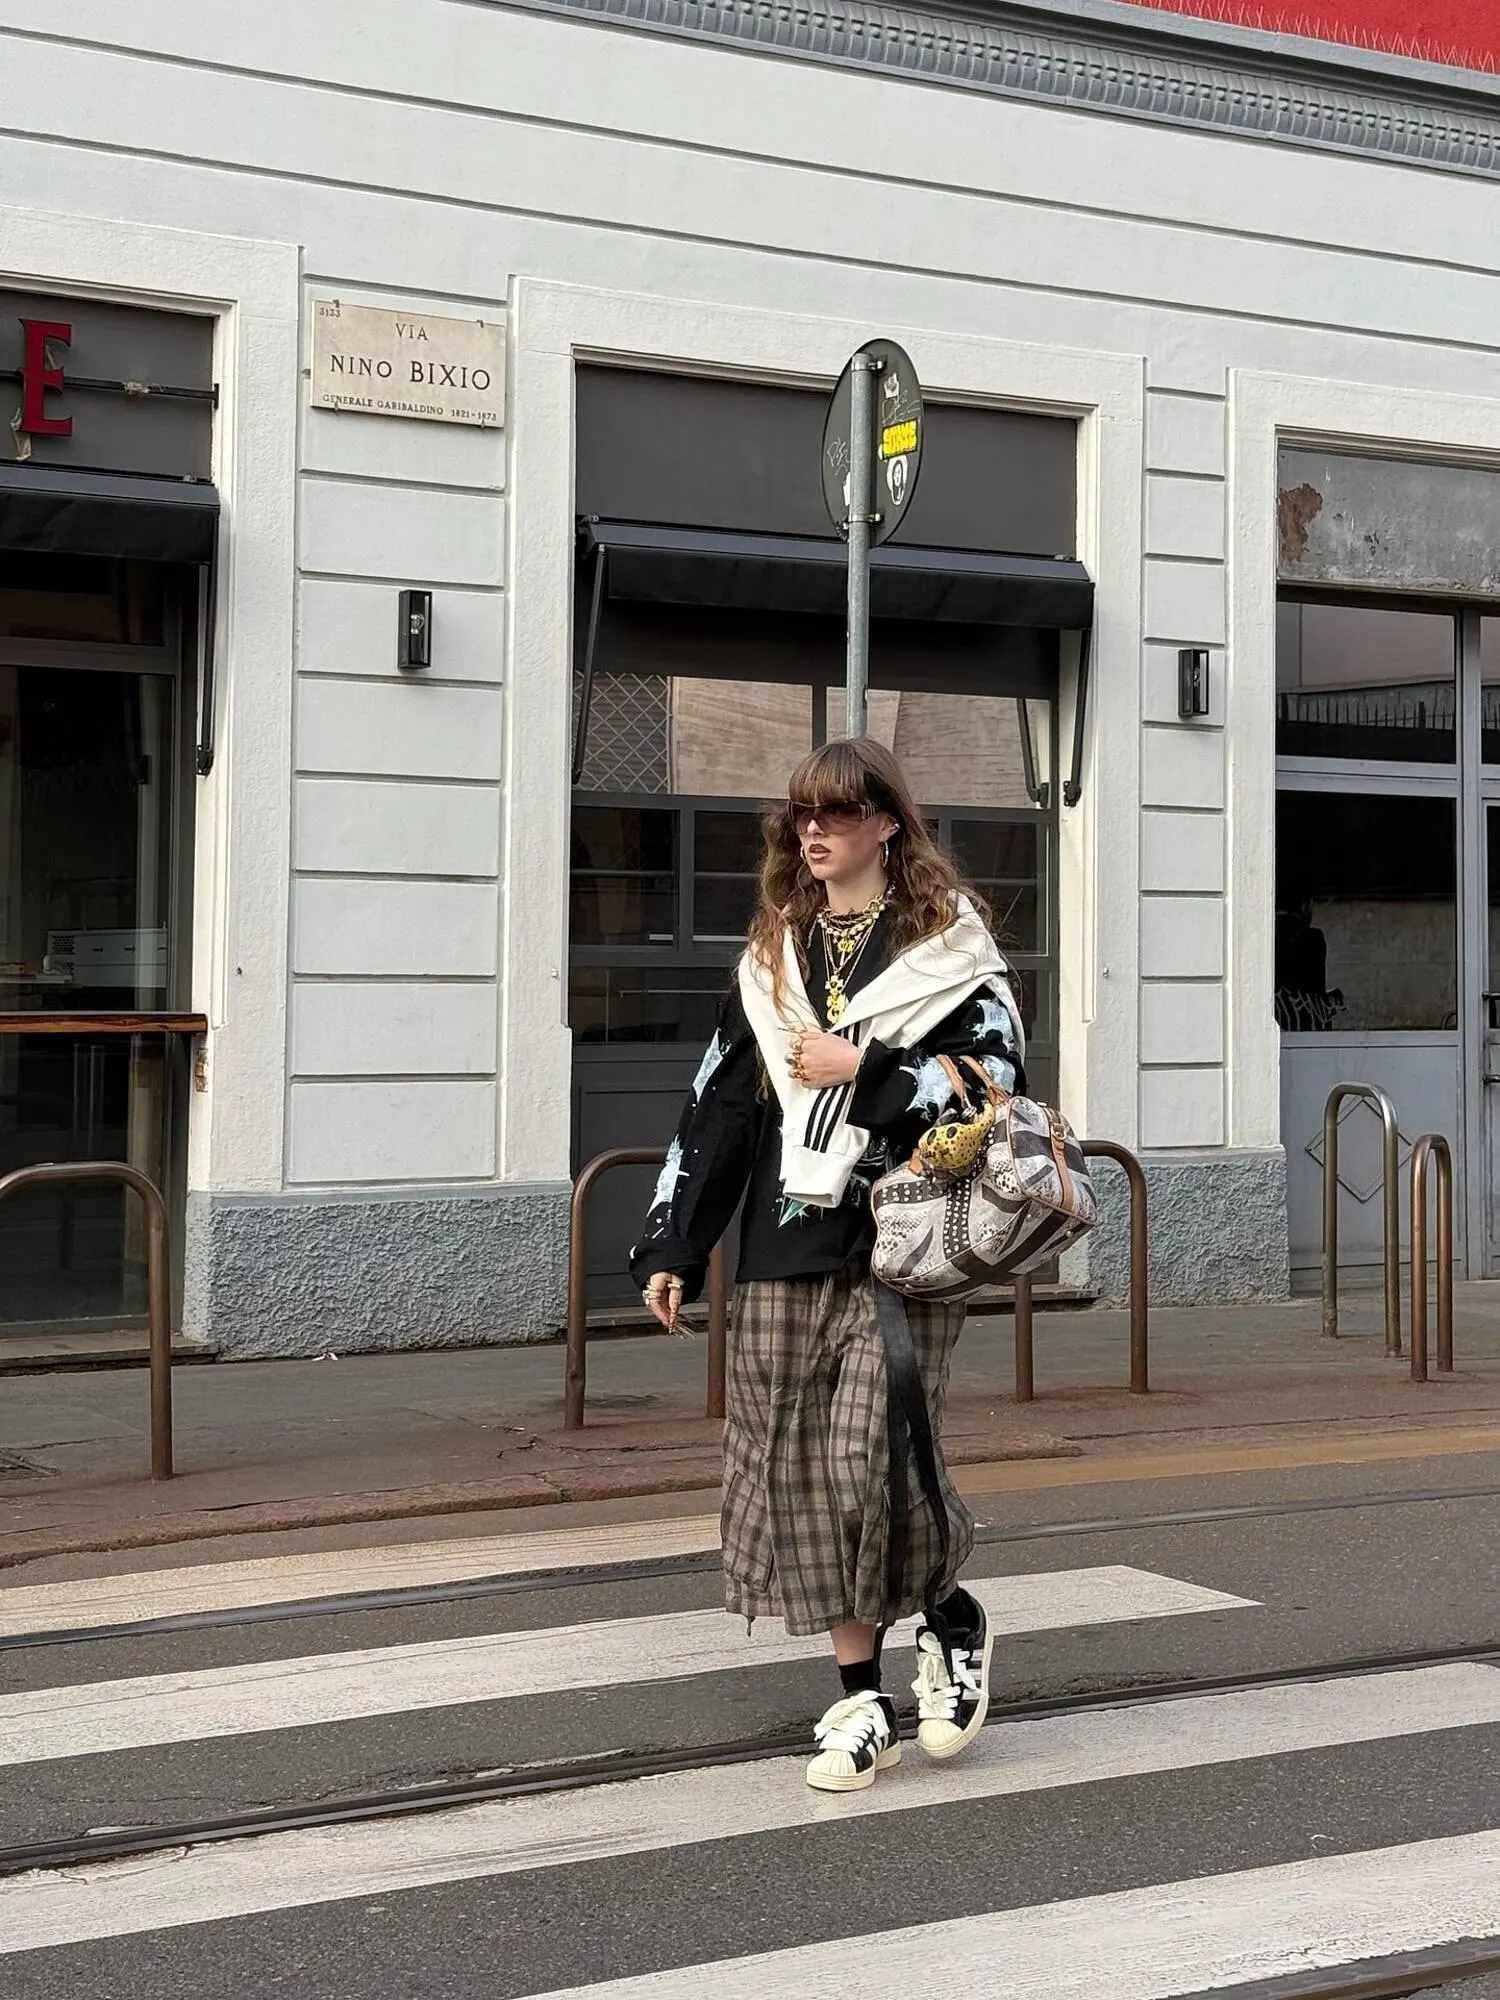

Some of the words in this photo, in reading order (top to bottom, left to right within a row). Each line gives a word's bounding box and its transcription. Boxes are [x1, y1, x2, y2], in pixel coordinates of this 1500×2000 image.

[319, 307, 341, 318] 3133
[396, 323, 428, 340] VIA
[17, 319, 73, 436] E
[331, 355, 392, 378] NINO
[410, 361, 490, 390] BIXIO
[322, 394, 373, 408] GENERALE
[377, 400, 444, 416] GARIBALDINO
